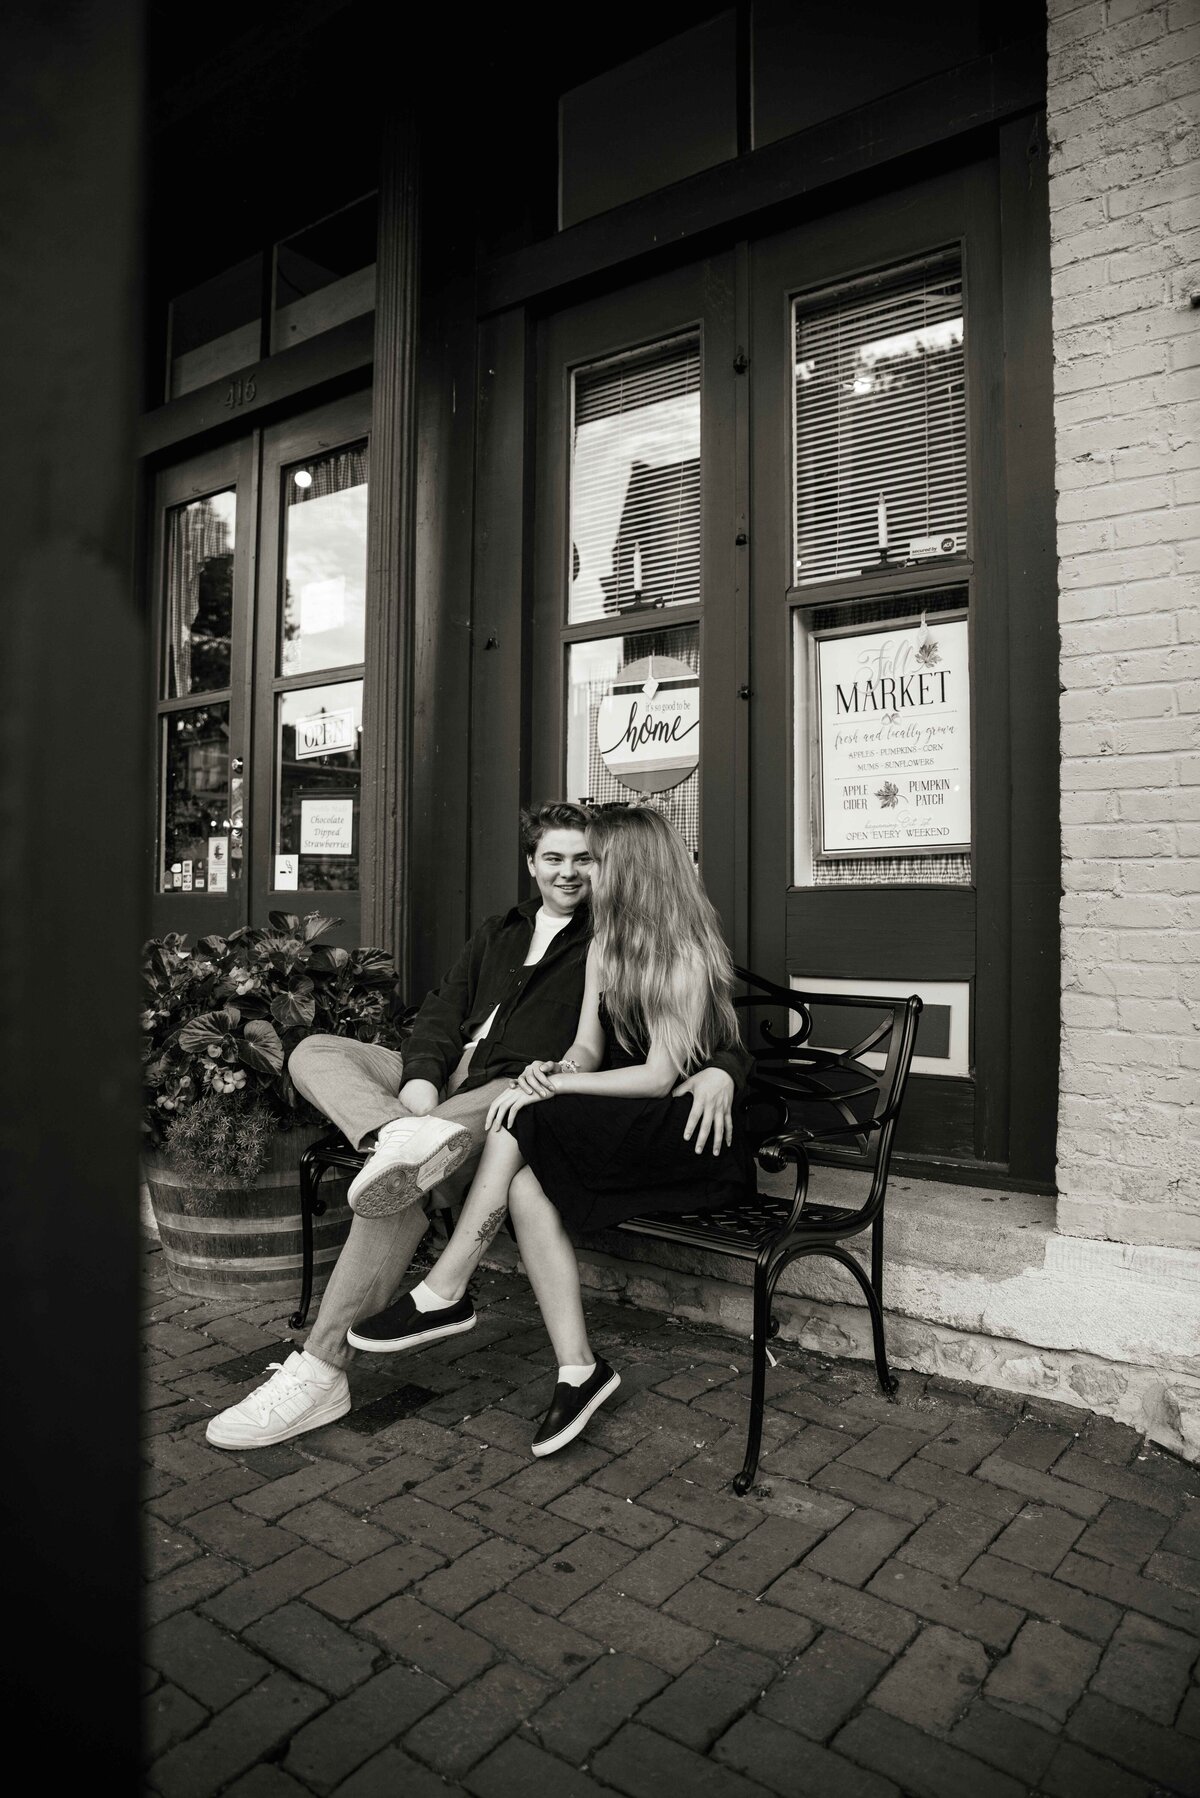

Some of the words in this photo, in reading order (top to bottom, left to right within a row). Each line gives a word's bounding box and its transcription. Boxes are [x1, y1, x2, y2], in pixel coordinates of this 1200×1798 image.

[224, 373, 257, 409] 416
[855, 640, 914, 693] Fall
[835, 670, 951, 715] MARKET
[645, 703, 654, 712] it's
[662, 701, 676, 713] good
[676, 702, 683, 711] to
[683, 702, 691, 711] be
[602, 701, 700, 754] home
[834, 730, 858, 750] fresh
[863, 725, 883, 742] and
[887, 722, 921, 745] locally
[925, 725, 955, 744] grown
[848, 750, 875, 759] APPLES
[880, 746, 917, 757] PUMPKINS
[922, 743, 944, 752] CORN
[857, 763, 879, 771] MUMS
[884, 758, 935, 769] SUNFLOWERS
[843, 784, 868, 797] APPLE
[909, 779, 951, 793] PUMPKIN
[843, 798, 868, 810] CIDER
[916, 794, 944, 806] PATCH
[311, 815, 345, 824] Chocolate
[314, 827, 342, 839] Dipped
[846, 832, 868, 841] OPEN
[872, 830, 901, 840] EVERY
[906, 827, 950, 838] WEEKEND
[304, 839, 350, 848] Strawberries
